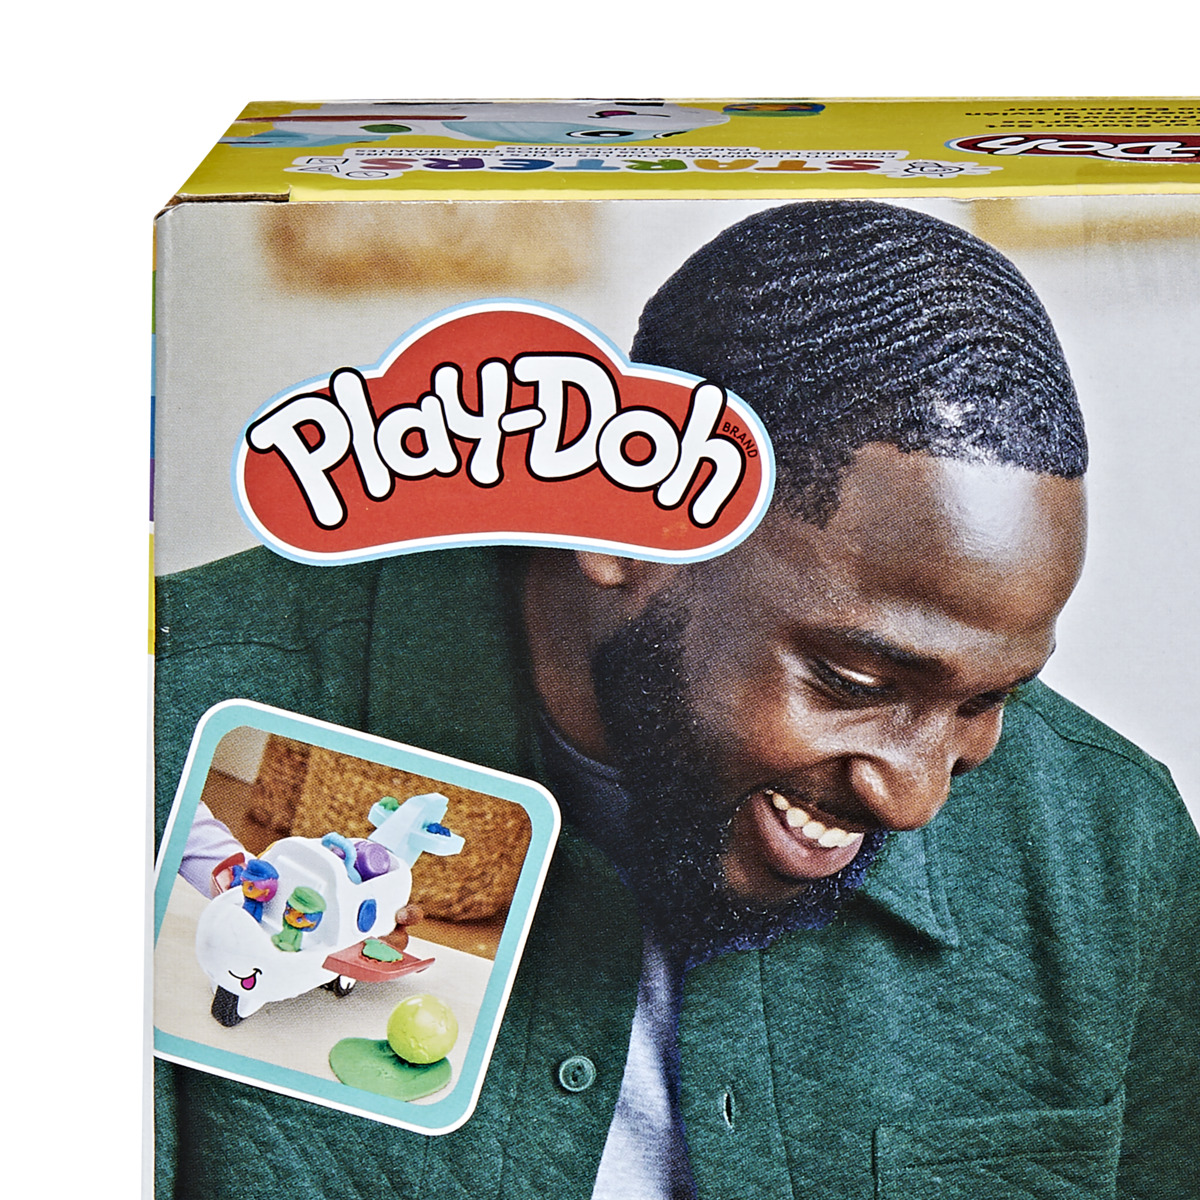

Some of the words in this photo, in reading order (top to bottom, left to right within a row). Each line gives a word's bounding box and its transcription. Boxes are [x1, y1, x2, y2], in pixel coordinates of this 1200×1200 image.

[360, 158, 884, 172] STARTERS
[246, 352, 747, 530] Play-Doh
[721, 420, 758, 459] BRAND
